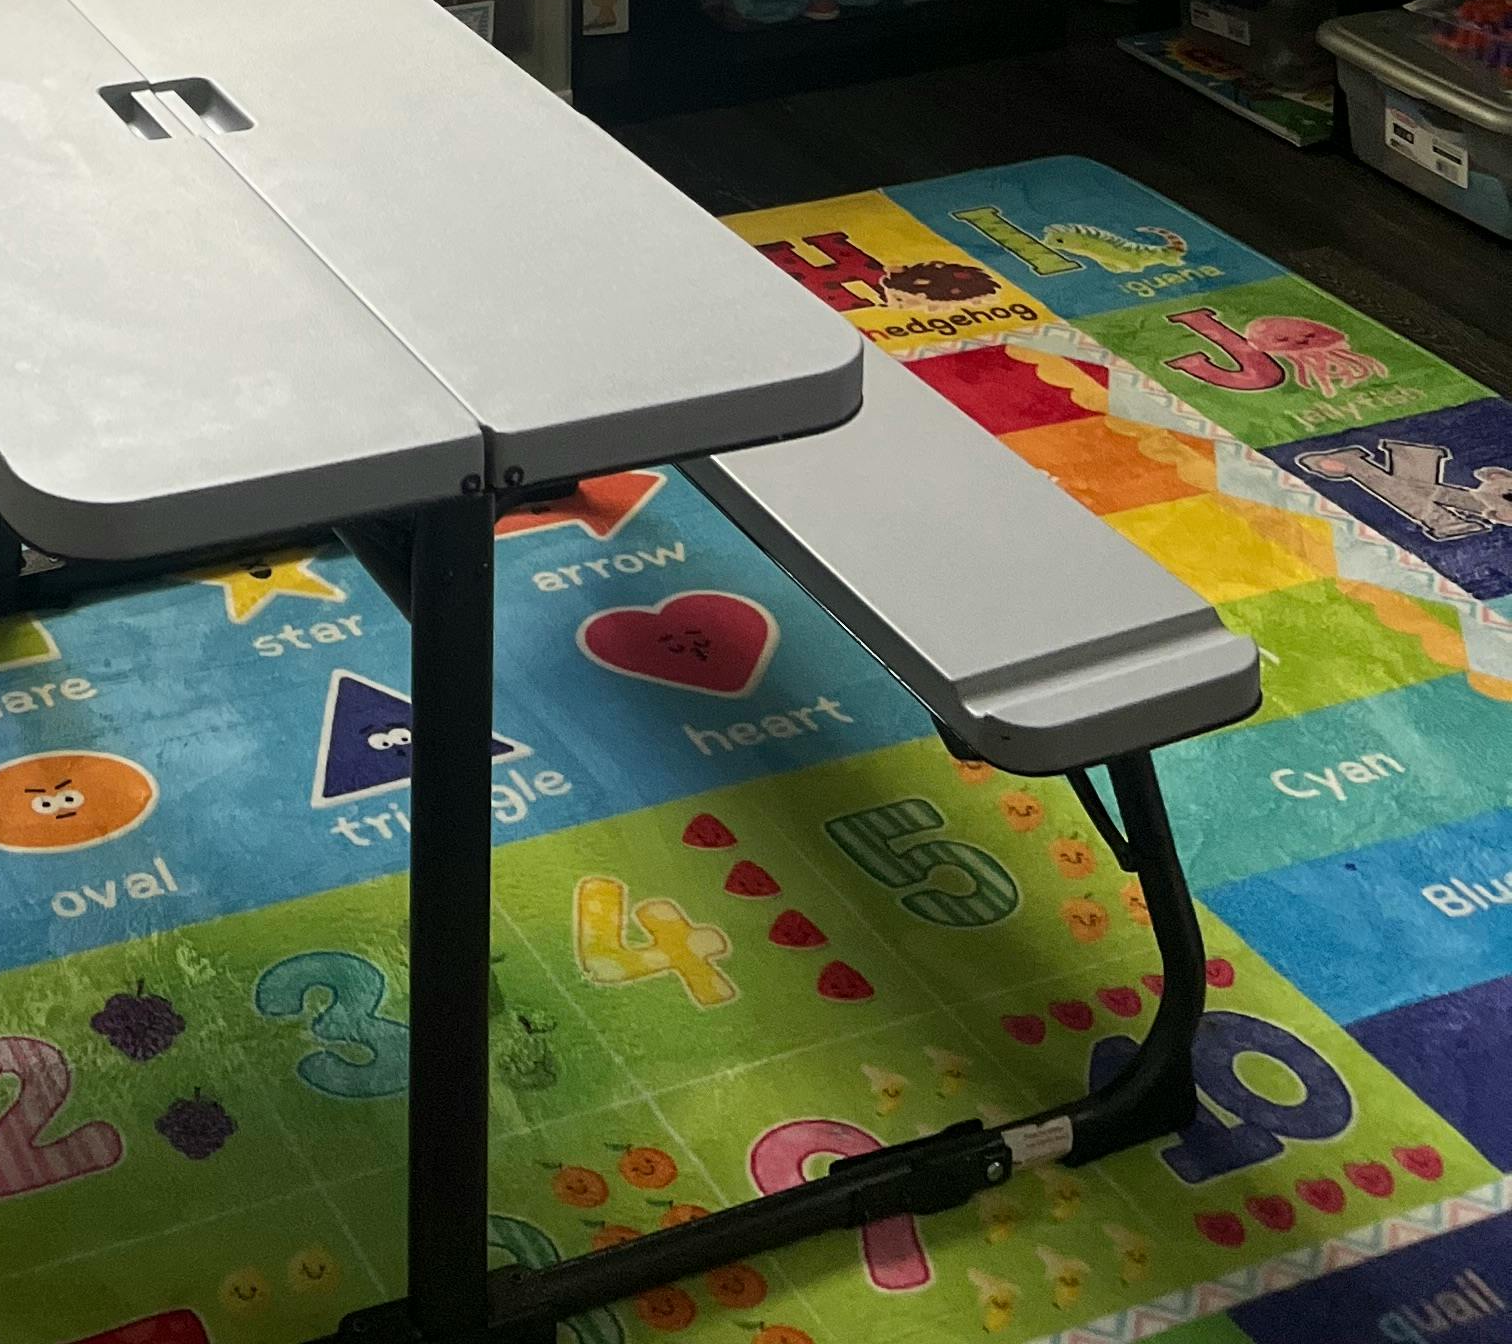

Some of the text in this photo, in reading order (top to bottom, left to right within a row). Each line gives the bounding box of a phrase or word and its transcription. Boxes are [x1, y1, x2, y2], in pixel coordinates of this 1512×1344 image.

[948, 206, 1090, 280] I
[1118, 263, 1226, 300] iguana
[1166, 308, 1287, 392] J
[1291, 385, 1427, 432] jellyfish
[1294, 439, 1498, 542] K
[532, 538, 687, 593] arrow
[251, 612, 365, 658] star
[683, 696, 854, 758] heart
[330, 766, 573, 848] trigle
[1270, 748, 1406, 802] Cyan
[49, 857, 180, 920] oval
[823, 798, 1021, 928] 5
[1421, 872, 1512, 918] Blu
[574, 875, 741, 1010] 4
[254, 949, 413, 1100] 3
[1378, 1268, 1506, 1344] quail
